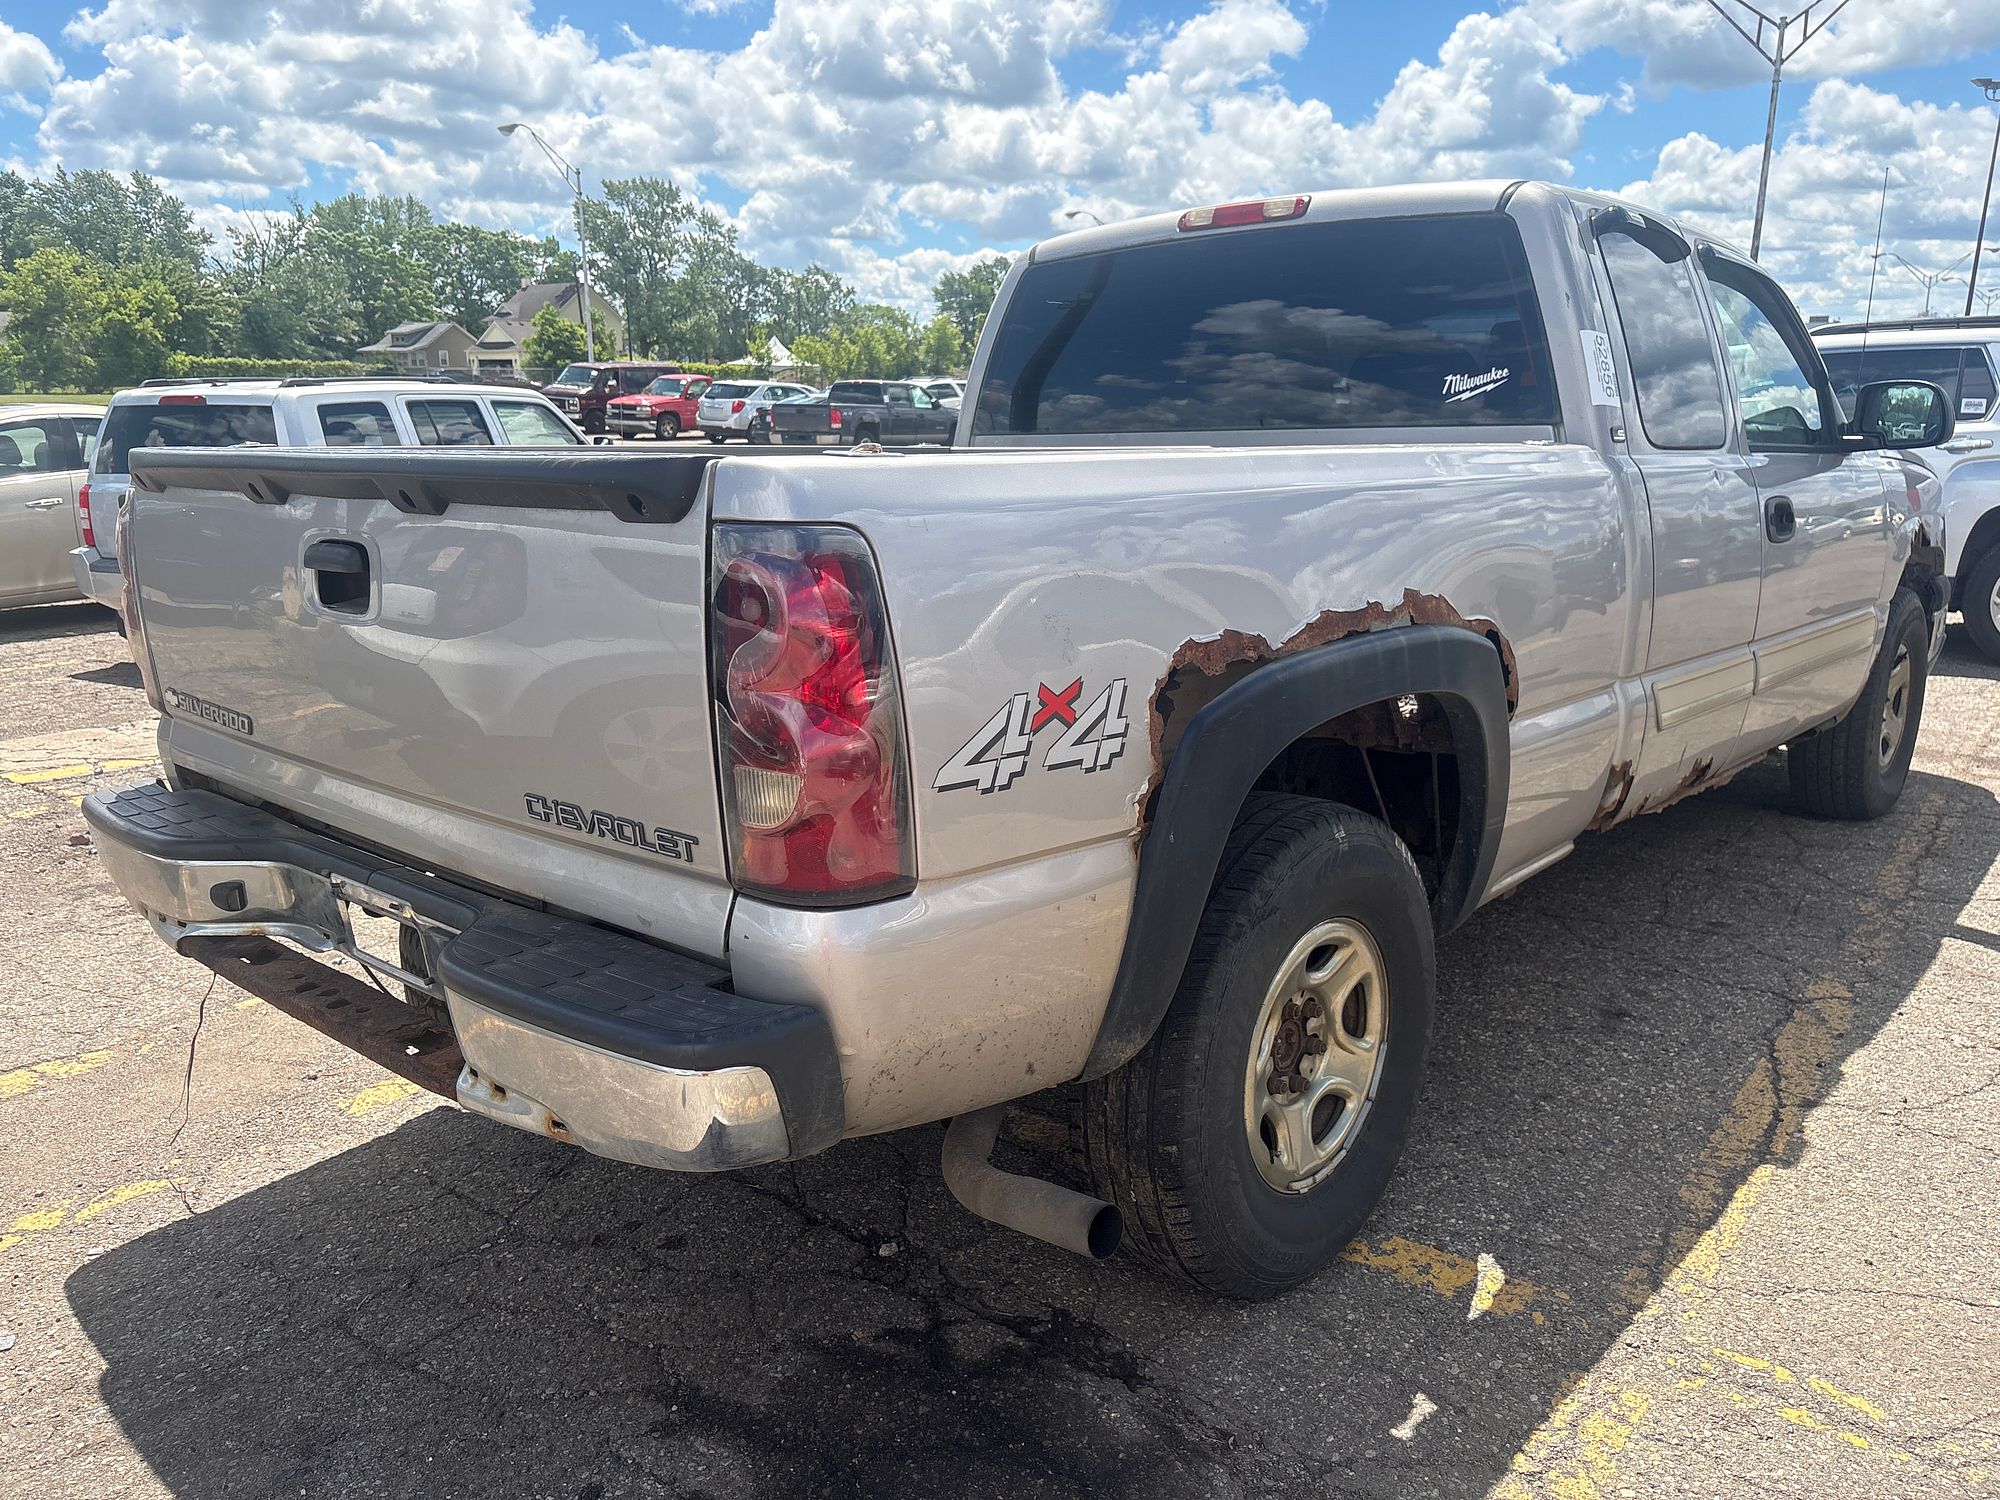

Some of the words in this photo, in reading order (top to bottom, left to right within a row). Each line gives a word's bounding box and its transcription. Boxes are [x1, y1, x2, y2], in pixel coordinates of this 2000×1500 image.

[1442, 367, 1510, 395] Milwaukee
[1595, 334, 1615, 398] 52856
[177, 692, 252, 735] SILVERADO
[523, 792, 699, 863] CHEVROLET
